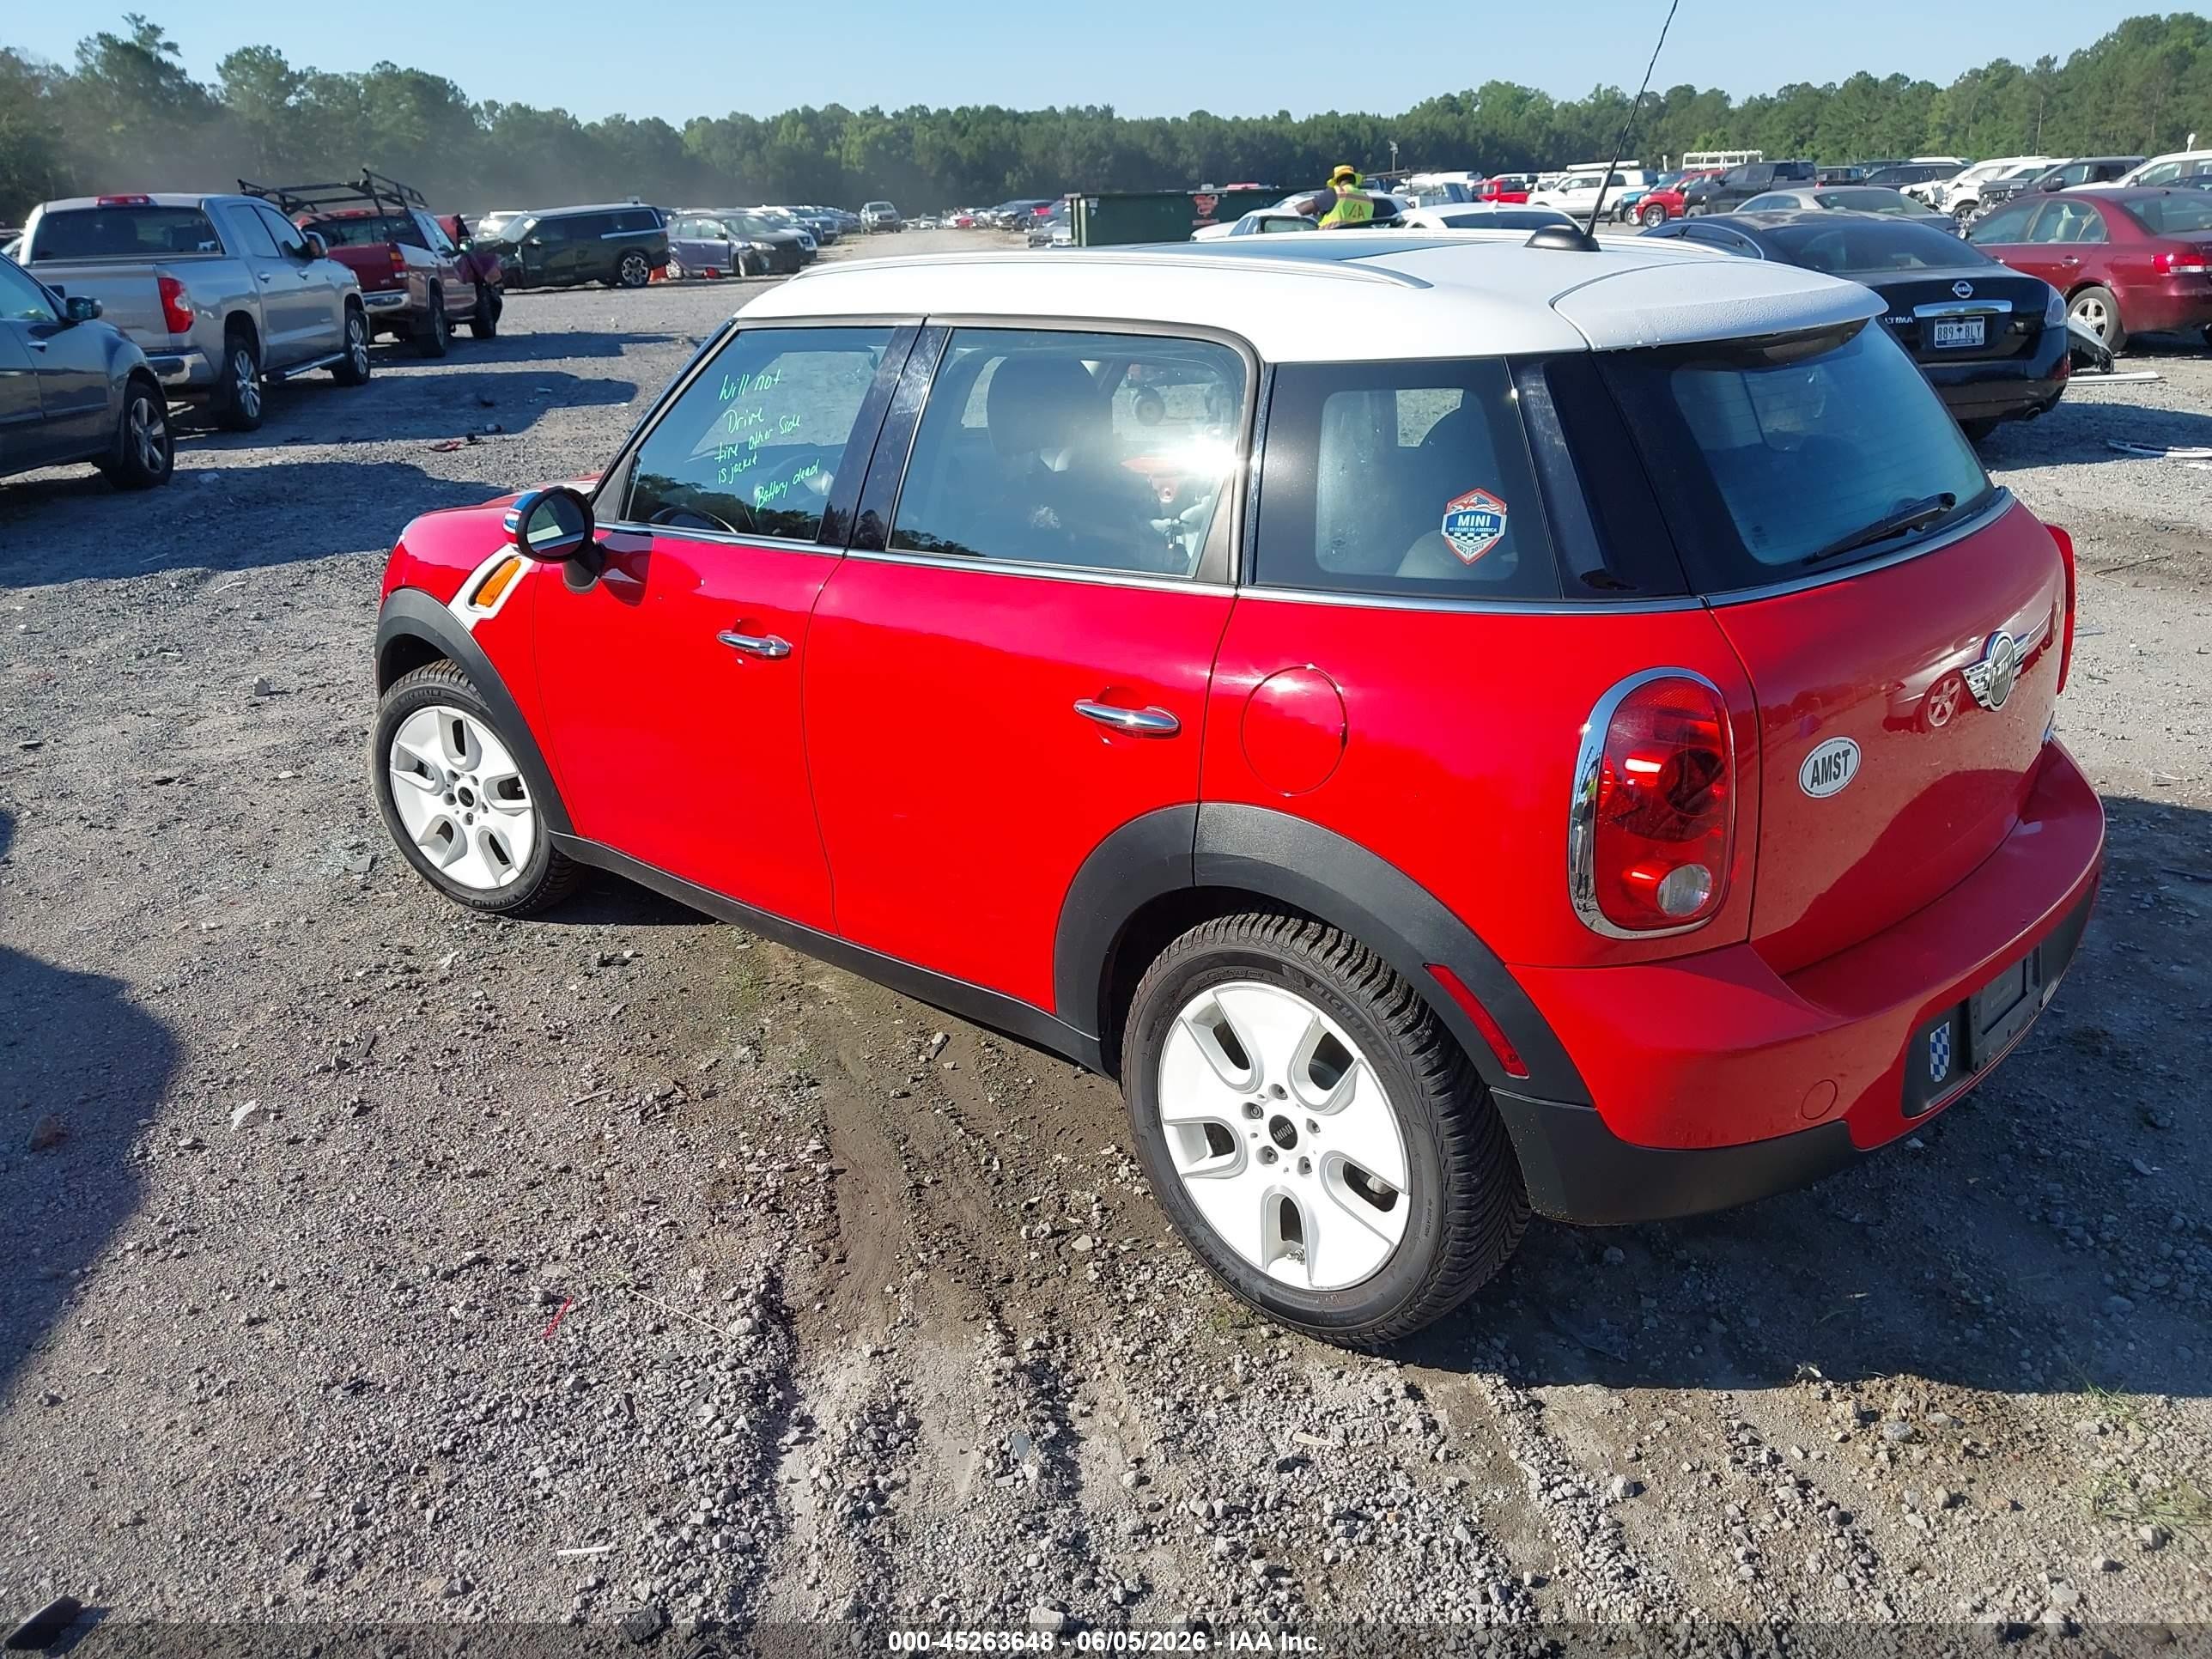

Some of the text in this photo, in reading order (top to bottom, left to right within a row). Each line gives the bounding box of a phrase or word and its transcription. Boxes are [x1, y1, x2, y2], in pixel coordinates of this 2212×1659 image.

[1884, 315, 1914, 325] LTIMA
[719, 368, 782, 401] Will not
[722, 407, 764, 434] Drive
[755, 459, 820, 513] Battery dead
[1456, 514, 1492, 527] MINI
[1810, 748, 1850, 789] AMST
[1273, 1122, 1294, 1144] MINI
